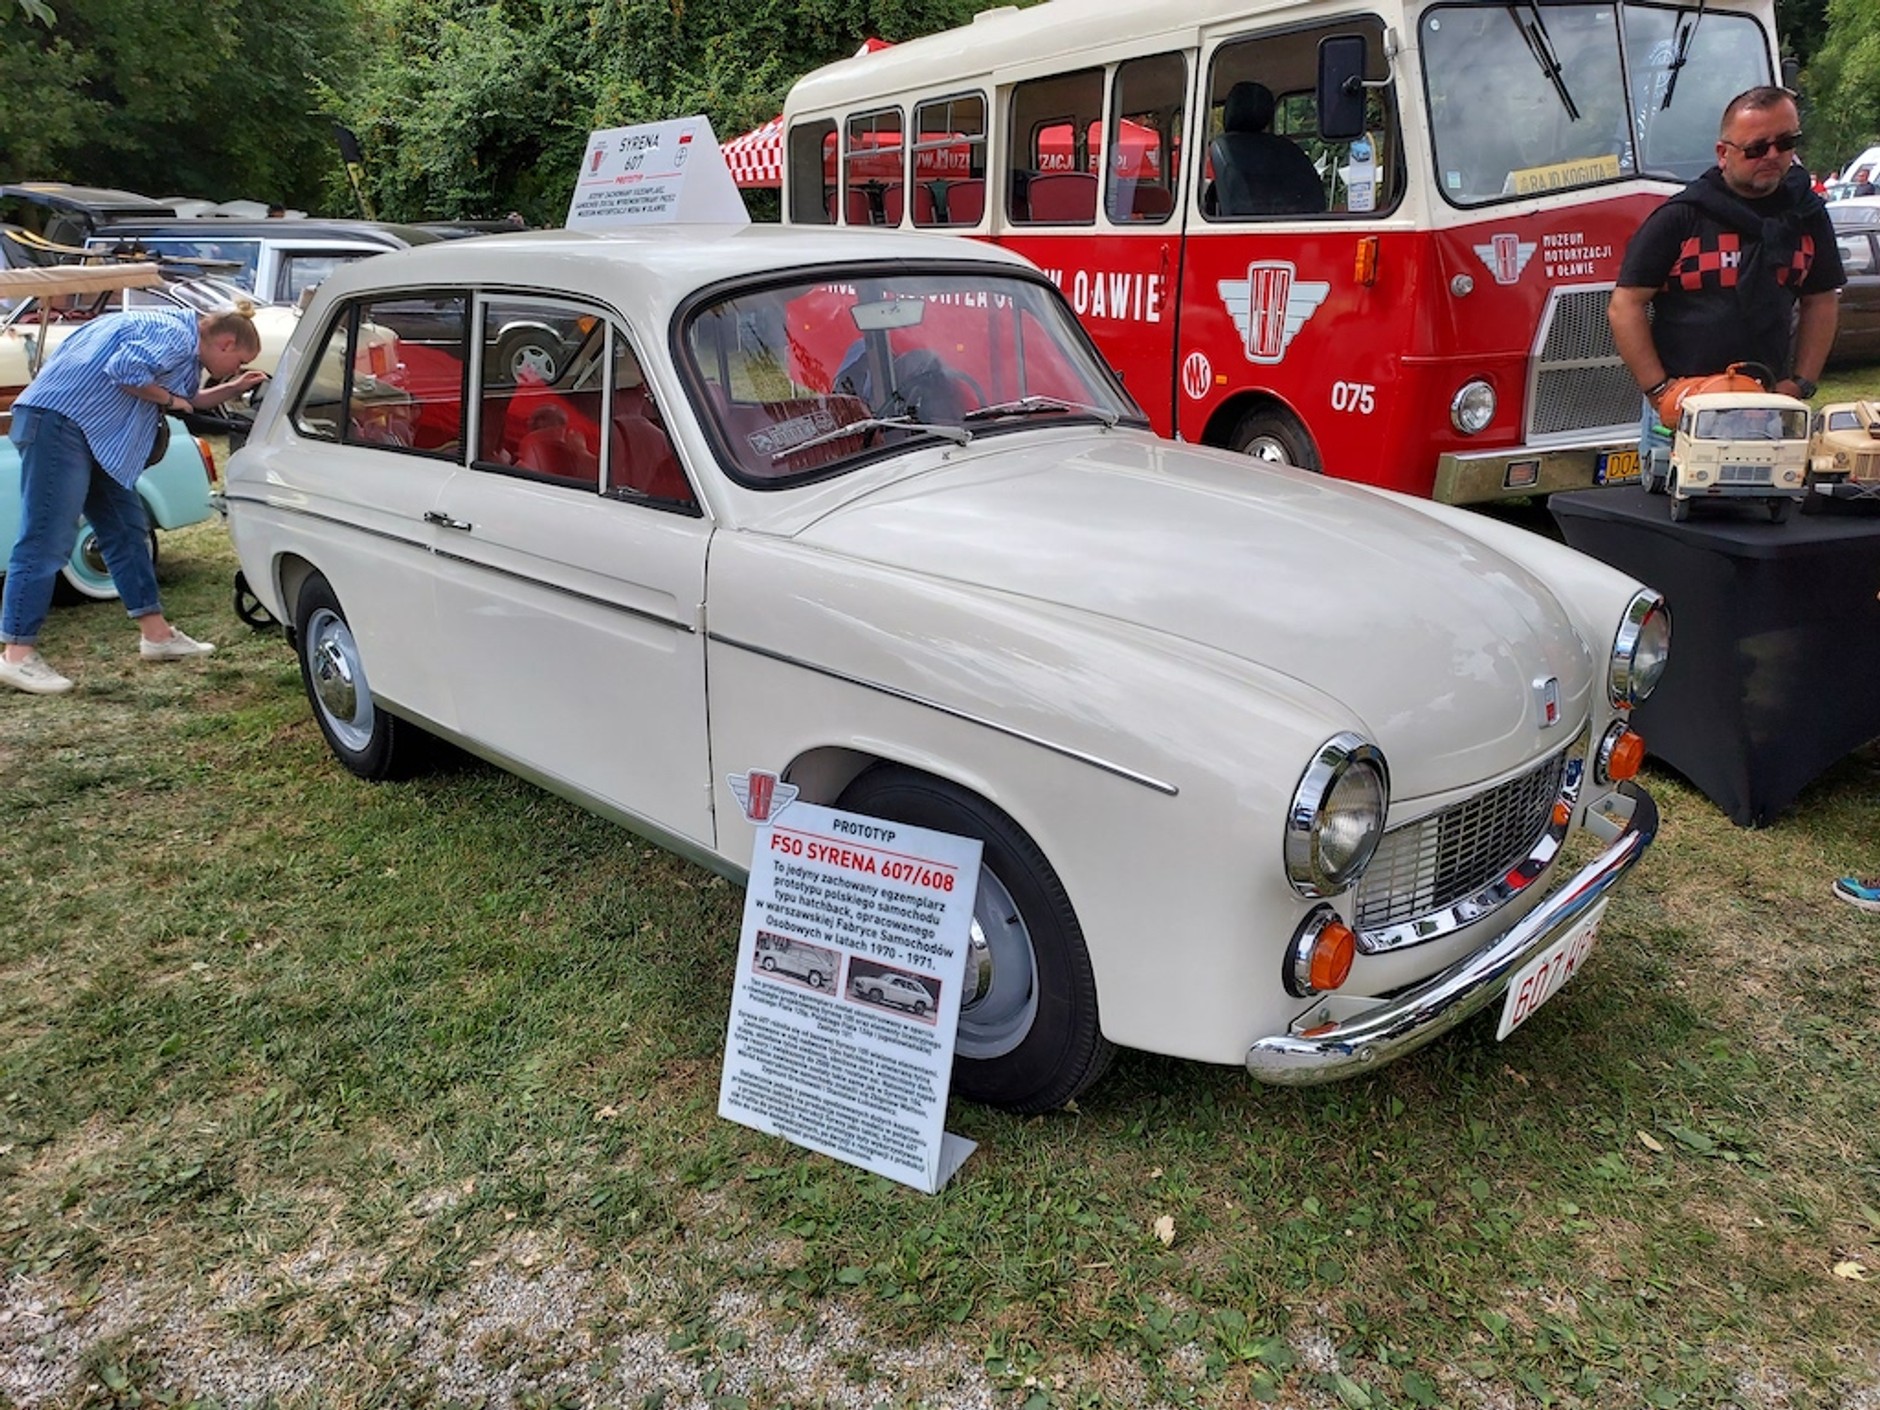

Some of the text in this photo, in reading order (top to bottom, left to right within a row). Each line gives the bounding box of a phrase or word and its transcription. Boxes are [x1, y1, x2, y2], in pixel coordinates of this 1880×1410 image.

[619, 133, 659, 152] SYRENA
[624, 155, 643, 170] 607
[1543, 233, 1584, 247] MUZEUM
[1544, 246, 1611, 262] MOTORYZACJI
[1546, 262, 1594, 277] W OŁAWIE
[1331, 381, 1375, 414] 075
[832, 818, 896, 844] PROTOTYP
[770, 833, 955, 892] FSO SYRENA 607/608
[773, 860, 946, 914] To jedyny zachowany egzemplarz
[773, 875, 940, 925] prototypu polskiego samochodu
[765, 899, 834, 929] warszawskiej
[836, 918, 878, 941] Fabryce
[879, 929, 954, 959] Samochodów
[774, 889, 935, 942] typu hatchback, opracowanego
[765, 914, 822, 941] Osobowych
[835, 932, 867, 951] latach
[870, 942, 895, 959] 1970
[906, 952, 936, 970] 1971.
[1513, 952, 1563, 1025] 607
